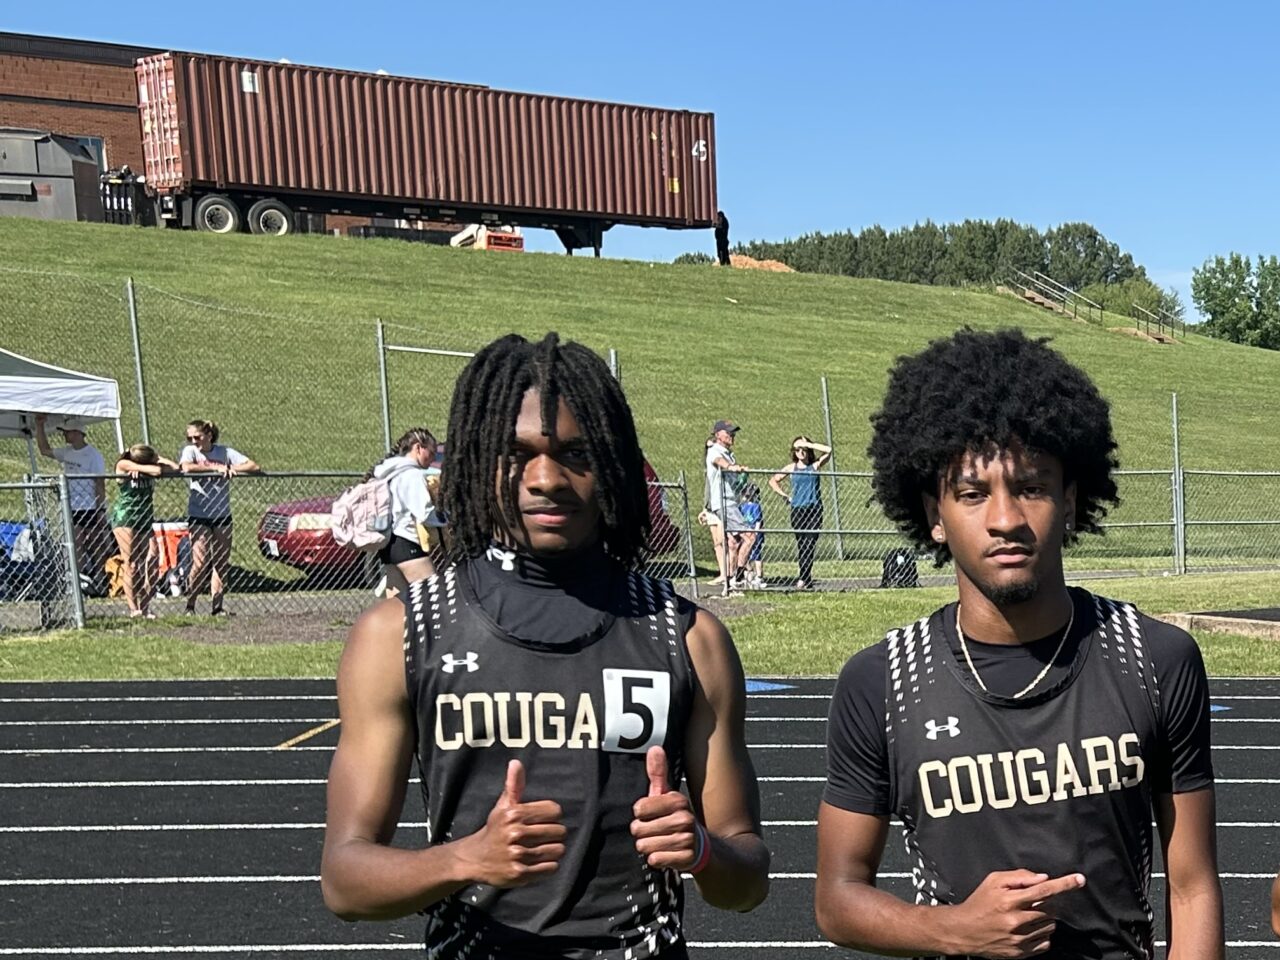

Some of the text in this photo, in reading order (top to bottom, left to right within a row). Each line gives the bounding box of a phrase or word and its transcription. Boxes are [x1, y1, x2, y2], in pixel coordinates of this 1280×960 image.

[435, 692, 600, 750] COUGA
[617, 676, 655, 751] 5
[918, 732, 1145, 819] COUGARS
